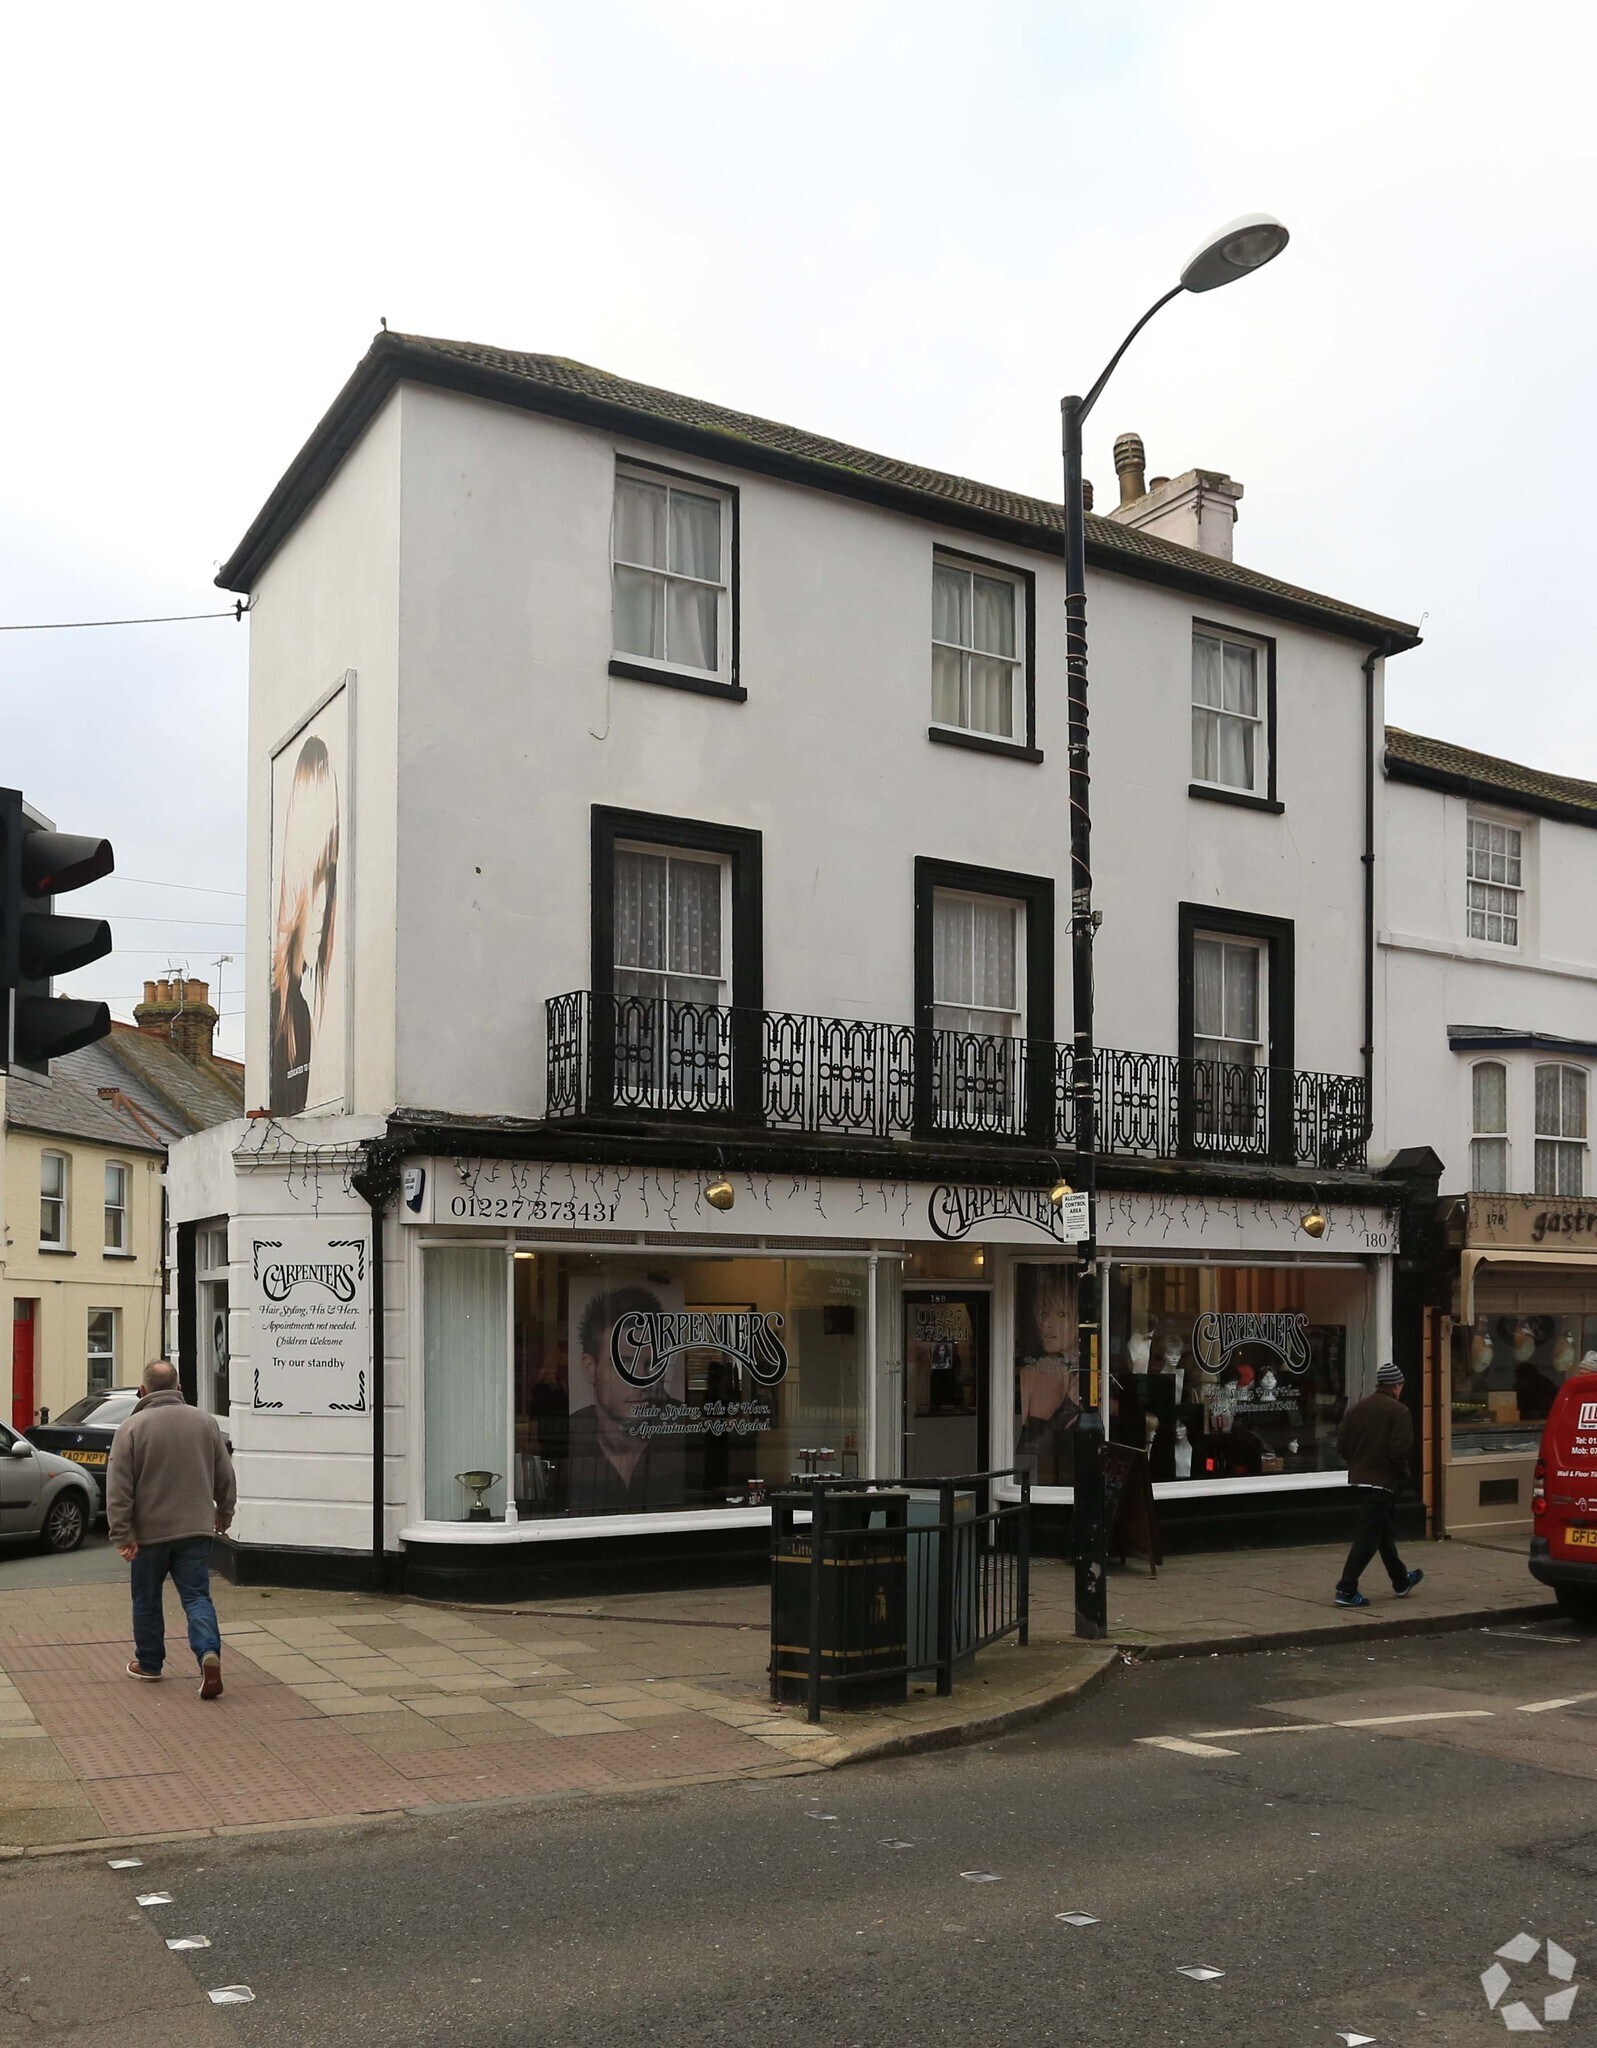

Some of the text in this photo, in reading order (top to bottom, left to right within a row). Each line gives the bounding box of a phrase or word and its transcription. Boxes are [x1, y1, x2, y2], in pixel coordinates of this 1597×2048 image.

[928, 1184, 1068, 1243] CARPENTER
[1365, 1232, 1387, 1248] 180
[263, 1264, 356, 1302] CARPENTERS
[259, 1303, 360, 1317] Hair Styling, His & Hers.
[262, 1321, 356, 1333] Appointments not needed.
[276, 1336, 343, 1347] Children Welcome
[610, 1311, 788, 1388] CARPENTERS
[1192, 1312, 1311, 1374] CARPENTERS
[272, 1357, 286, 1369] Try
[307, 1358, 346, 1371] standby
[630, 1401, 660, 1418] Hair
[727, 1402, 739, 1415] &
